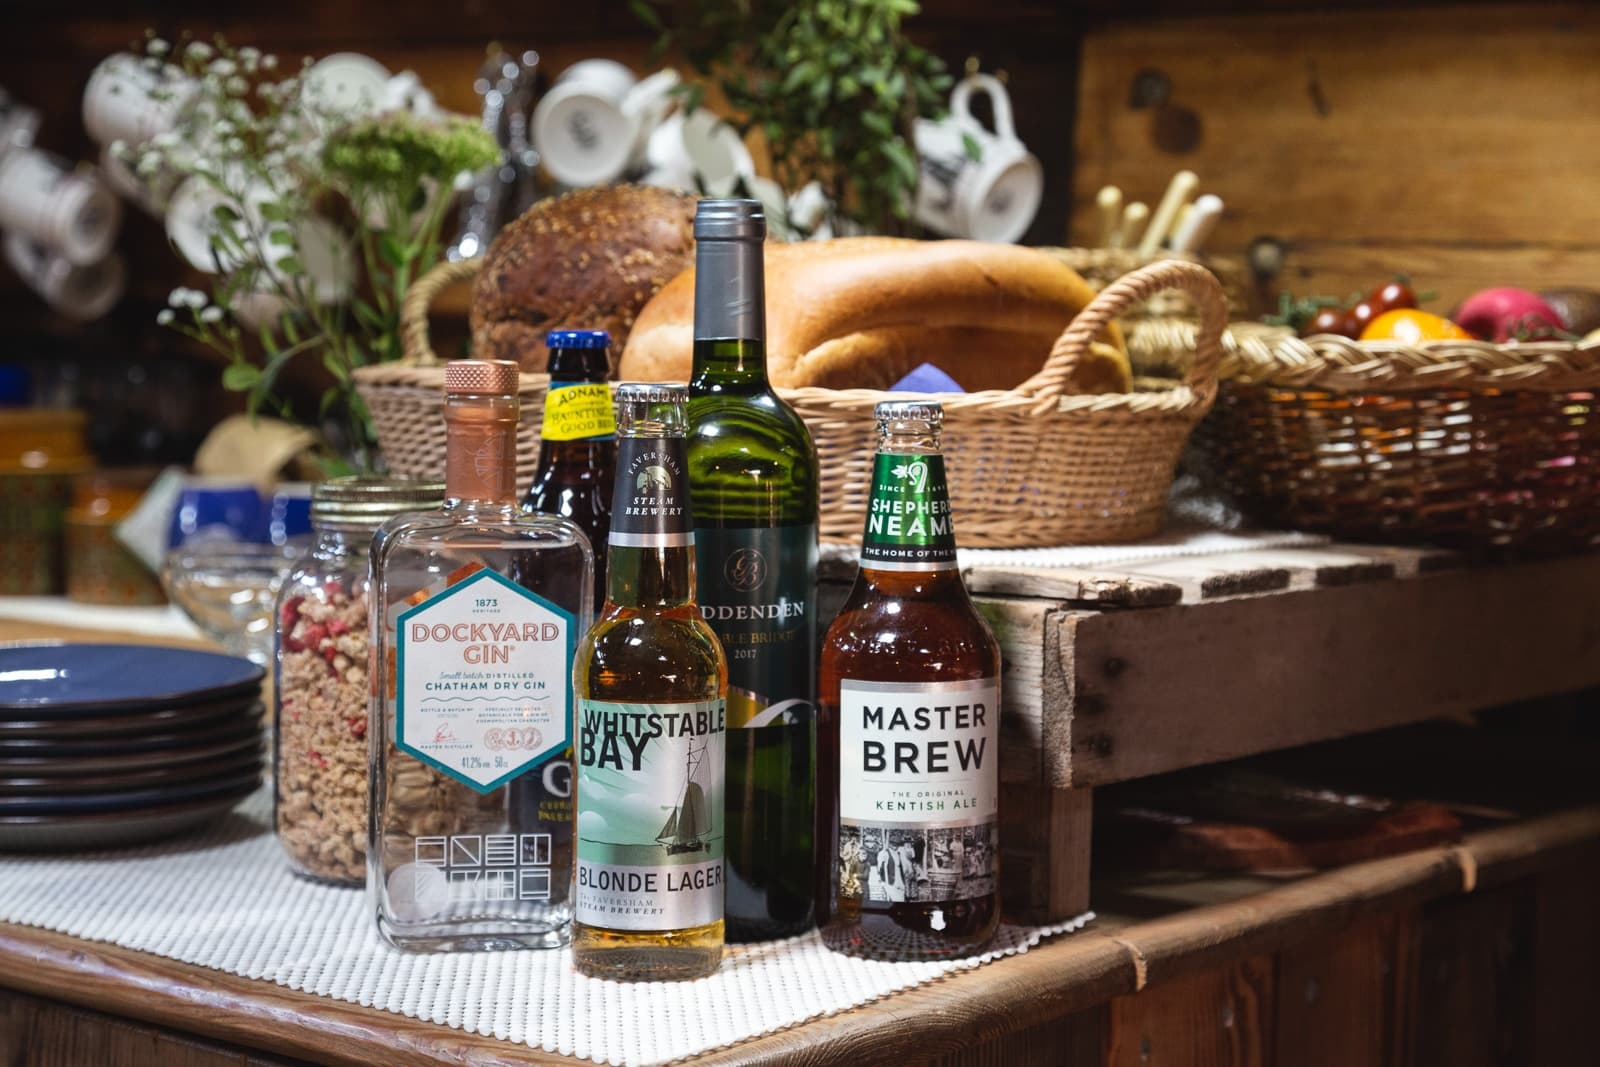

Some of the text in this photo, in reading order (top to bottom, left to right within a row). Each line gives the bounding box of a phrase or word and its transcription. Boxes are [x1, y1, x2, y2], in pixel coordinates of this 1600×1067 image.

[628, 451, 681, 476] FAVERSHAM
[879, 484, 905, 492] SINCE
[633, 497, 674, 505] STEAM
[625, 507, 683, 516] BREWERY
[865, 547, 880, 556] THE
[882, 549, 914, 557] HOME
[475, 599, 498, 607] 1873
[700, 601, 805, 620] DDENDEN
[411, 622, 560, 643] DOCKYARD
[463, 645, 509, 664] GIN
[734, 649, 757, 659] 2017
[425, 681, 545, 691] CHATHAM DRY GIN
[862, 703, 987, 731] MASTER
[584, 708, 725, 739] WHITSTABLE
[580, 726, 651, 772] BAY
[863, 737, 987, 774] BREW
[917, 789, 965, 798] ORIGINAL
[876, 798, 977, 811] KENTISH ALE
[580, 865, 722, 893] BLONDE LAGER
[592, 895, 653, 907] FAVERSHAM
[610, 907, 665, 915] BREWERY
